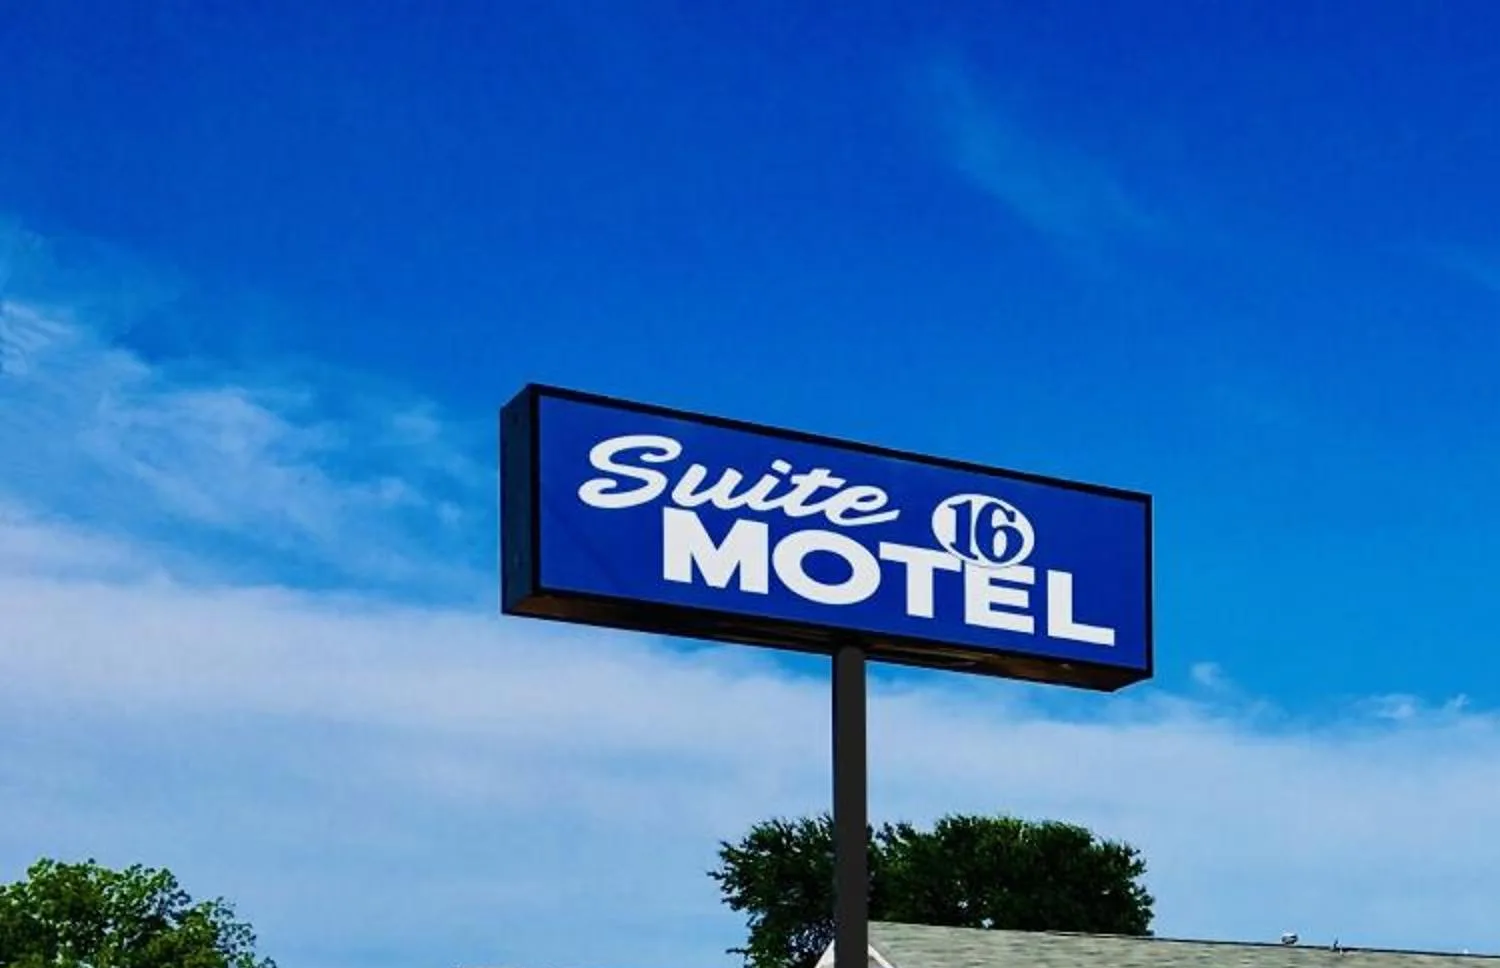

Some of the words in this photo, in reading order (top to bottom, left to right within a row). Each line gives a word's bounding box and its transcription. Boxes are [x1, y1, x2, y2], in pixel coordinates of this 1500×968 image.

[578, 435, 900, 526] Suite
[945, 496, 1026, 565] 16
[662, 506, 1116, 646] MOTEL
